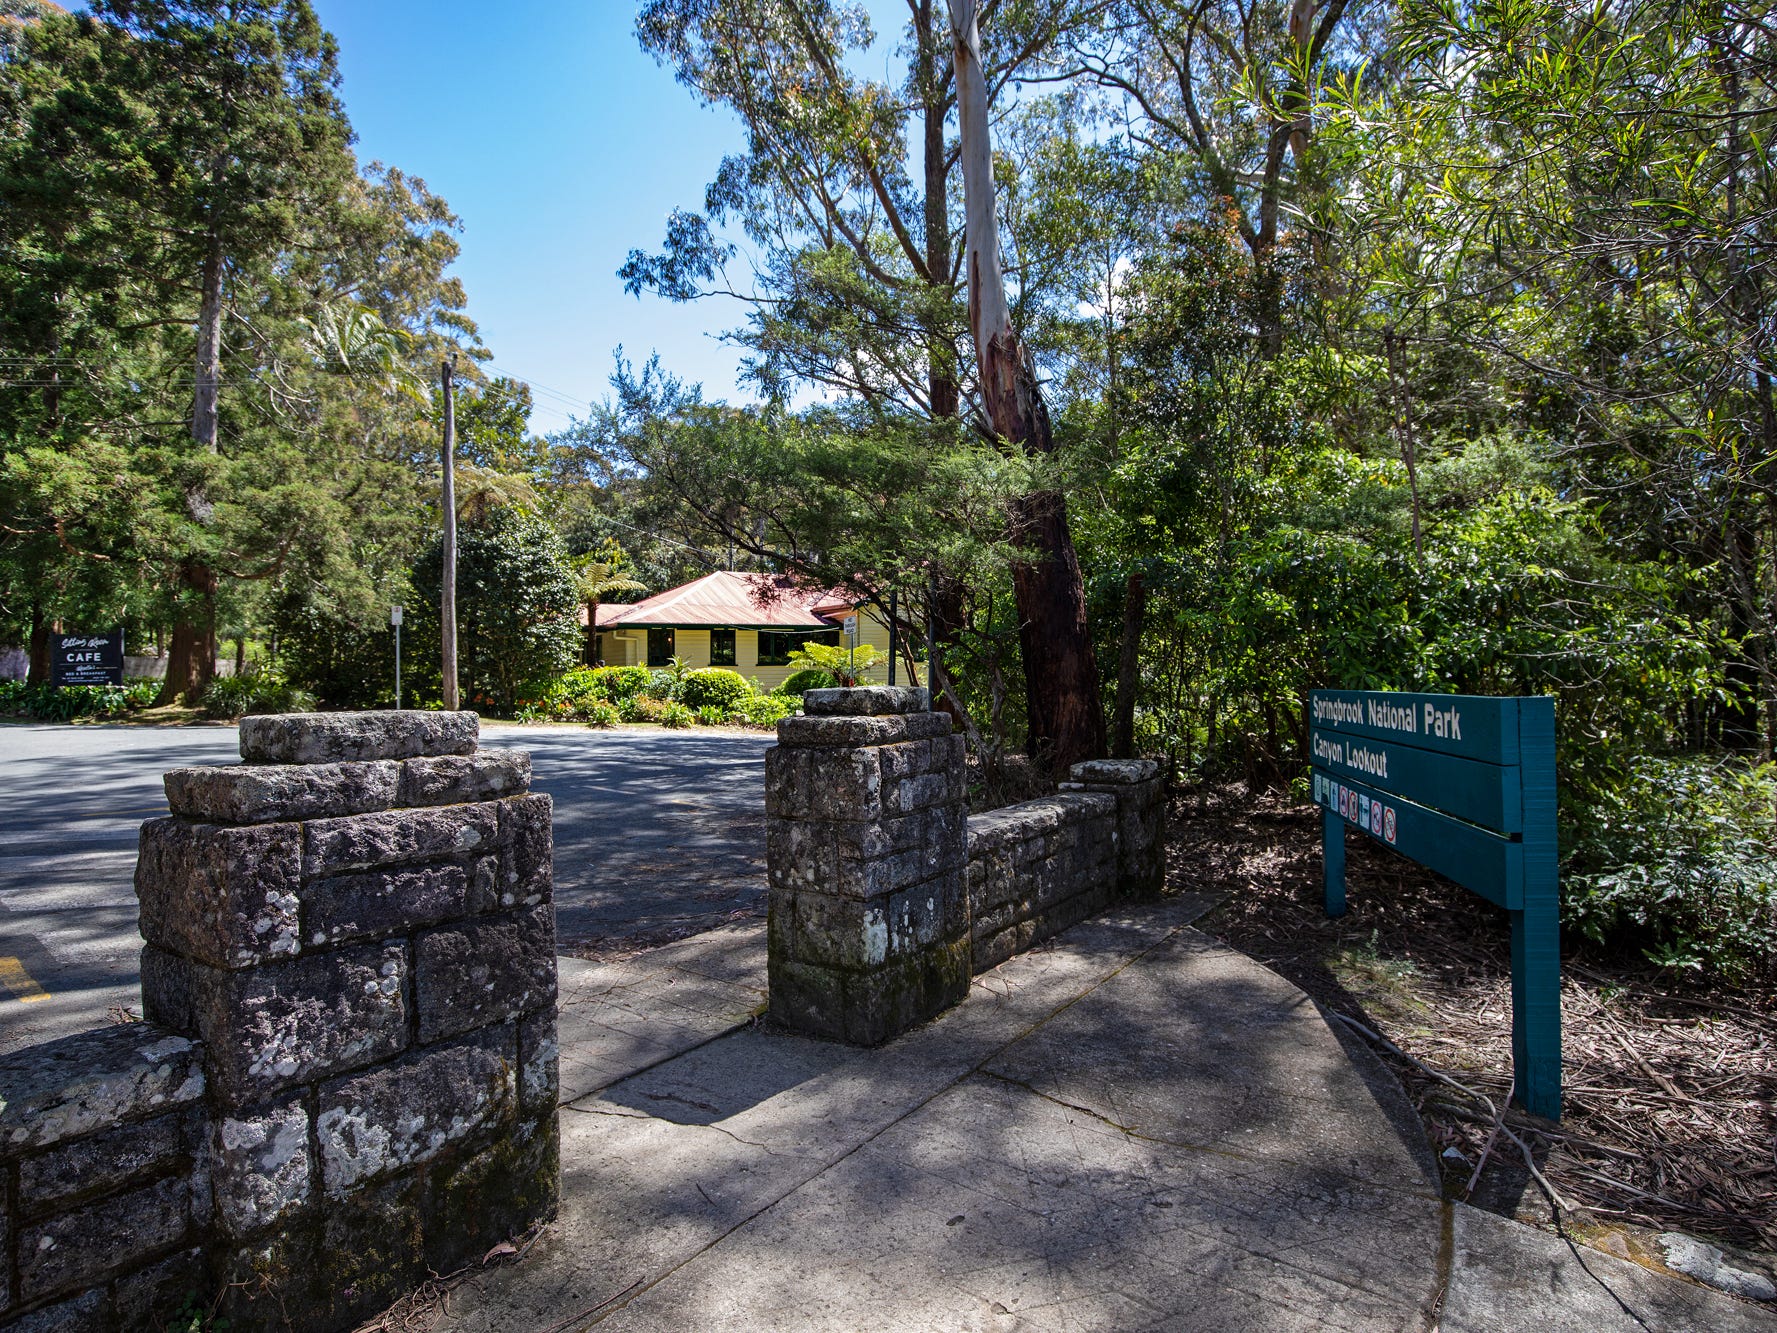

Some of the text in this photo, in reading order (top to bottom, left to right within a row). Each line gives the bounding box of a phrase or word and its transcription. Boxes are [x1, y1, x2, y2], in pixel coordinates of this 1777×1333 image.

[66, 653, 101, 662] CAFE
[1313, 695, 1461, 740] Springbrook National Park
[1313, 732, 1388, 778] Canyon Lookout
